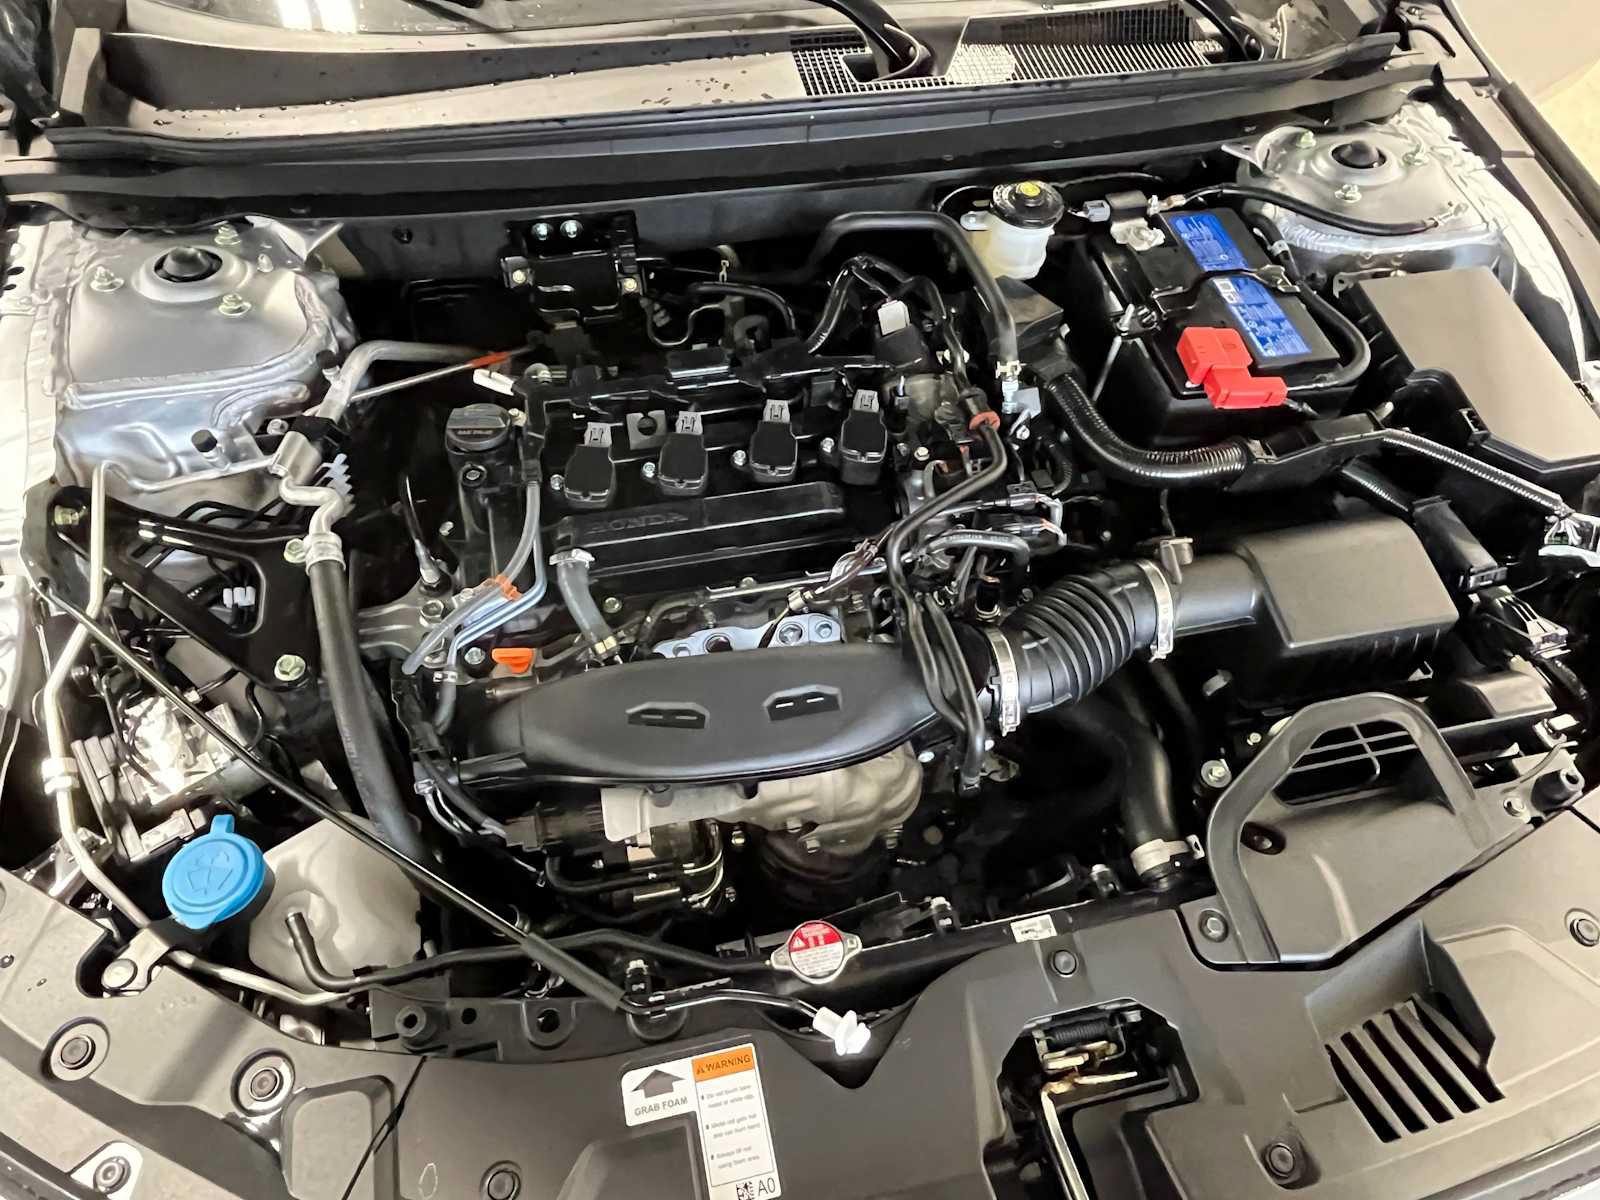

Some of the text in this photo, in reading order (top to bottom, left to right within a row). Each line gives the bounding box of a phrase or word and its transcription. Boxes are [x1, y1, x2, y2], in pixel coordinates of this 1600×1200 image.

[705, 1054, 751, 1071] WARNING
[634, 1096, 688, 1116] GRAB FOAM
